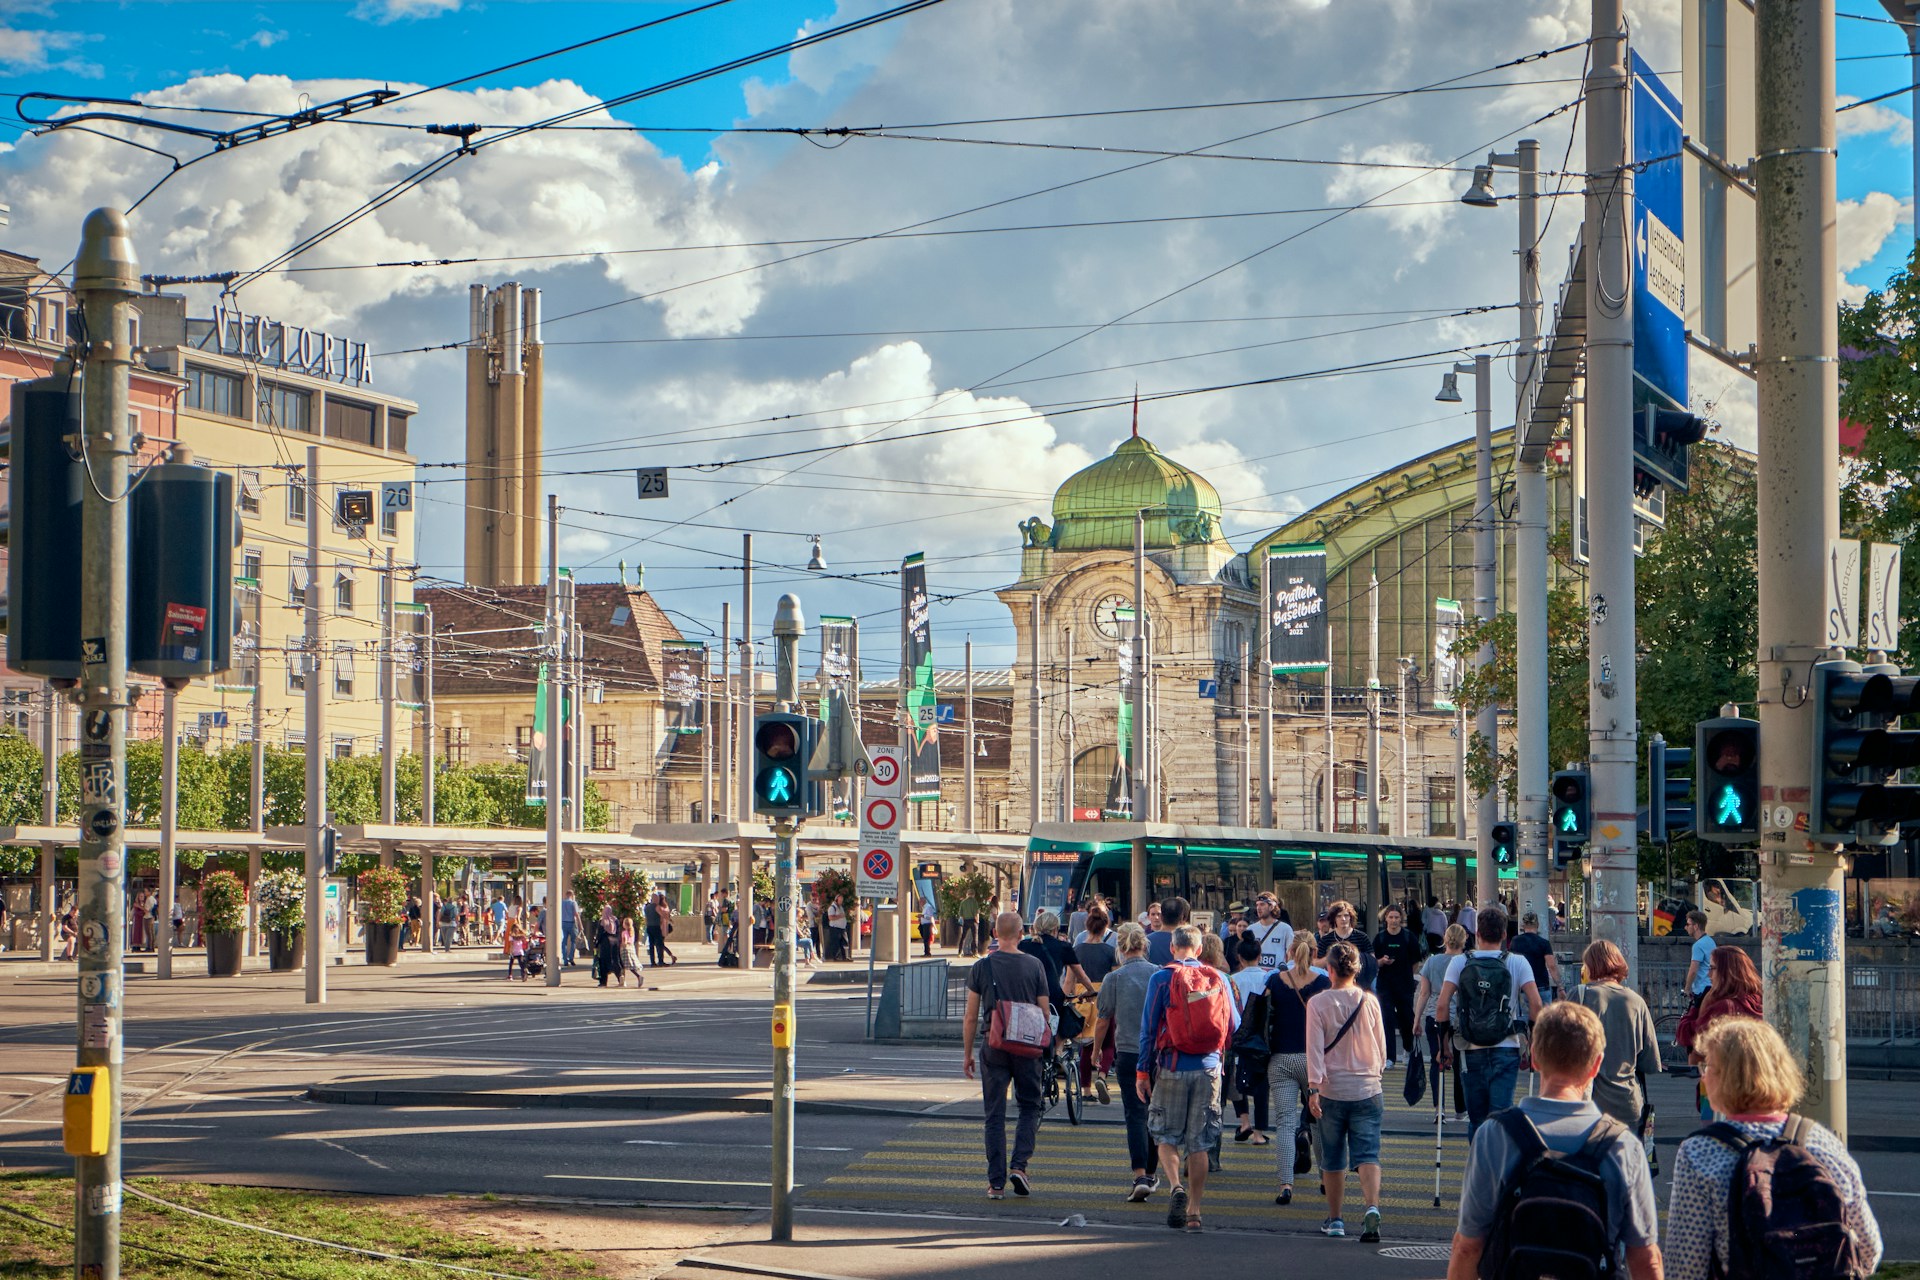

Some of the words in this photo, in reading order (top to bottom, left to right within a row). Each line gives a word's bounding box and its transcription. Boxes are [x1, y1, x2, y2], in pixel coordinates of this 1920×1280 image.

[212, 304, 374, 384] VICTORIA
[641, 474, 664, 493] 25
[385, 487, 409, 507] 20
[1276, 584, 1317, 607] Pratteln
[1273, 597, 1323, 626] Baselbiet
[1289, 628, 1304, 636] 2022
[1829, 608, 1839, 640] S
[1871, 612, 1880, 644] S
[200, 715, 211, 726] 25
[920, 708, 934, 721] 25
[877, 747, 895, 755] ZONE
[878, 765, 891, 777] 30
